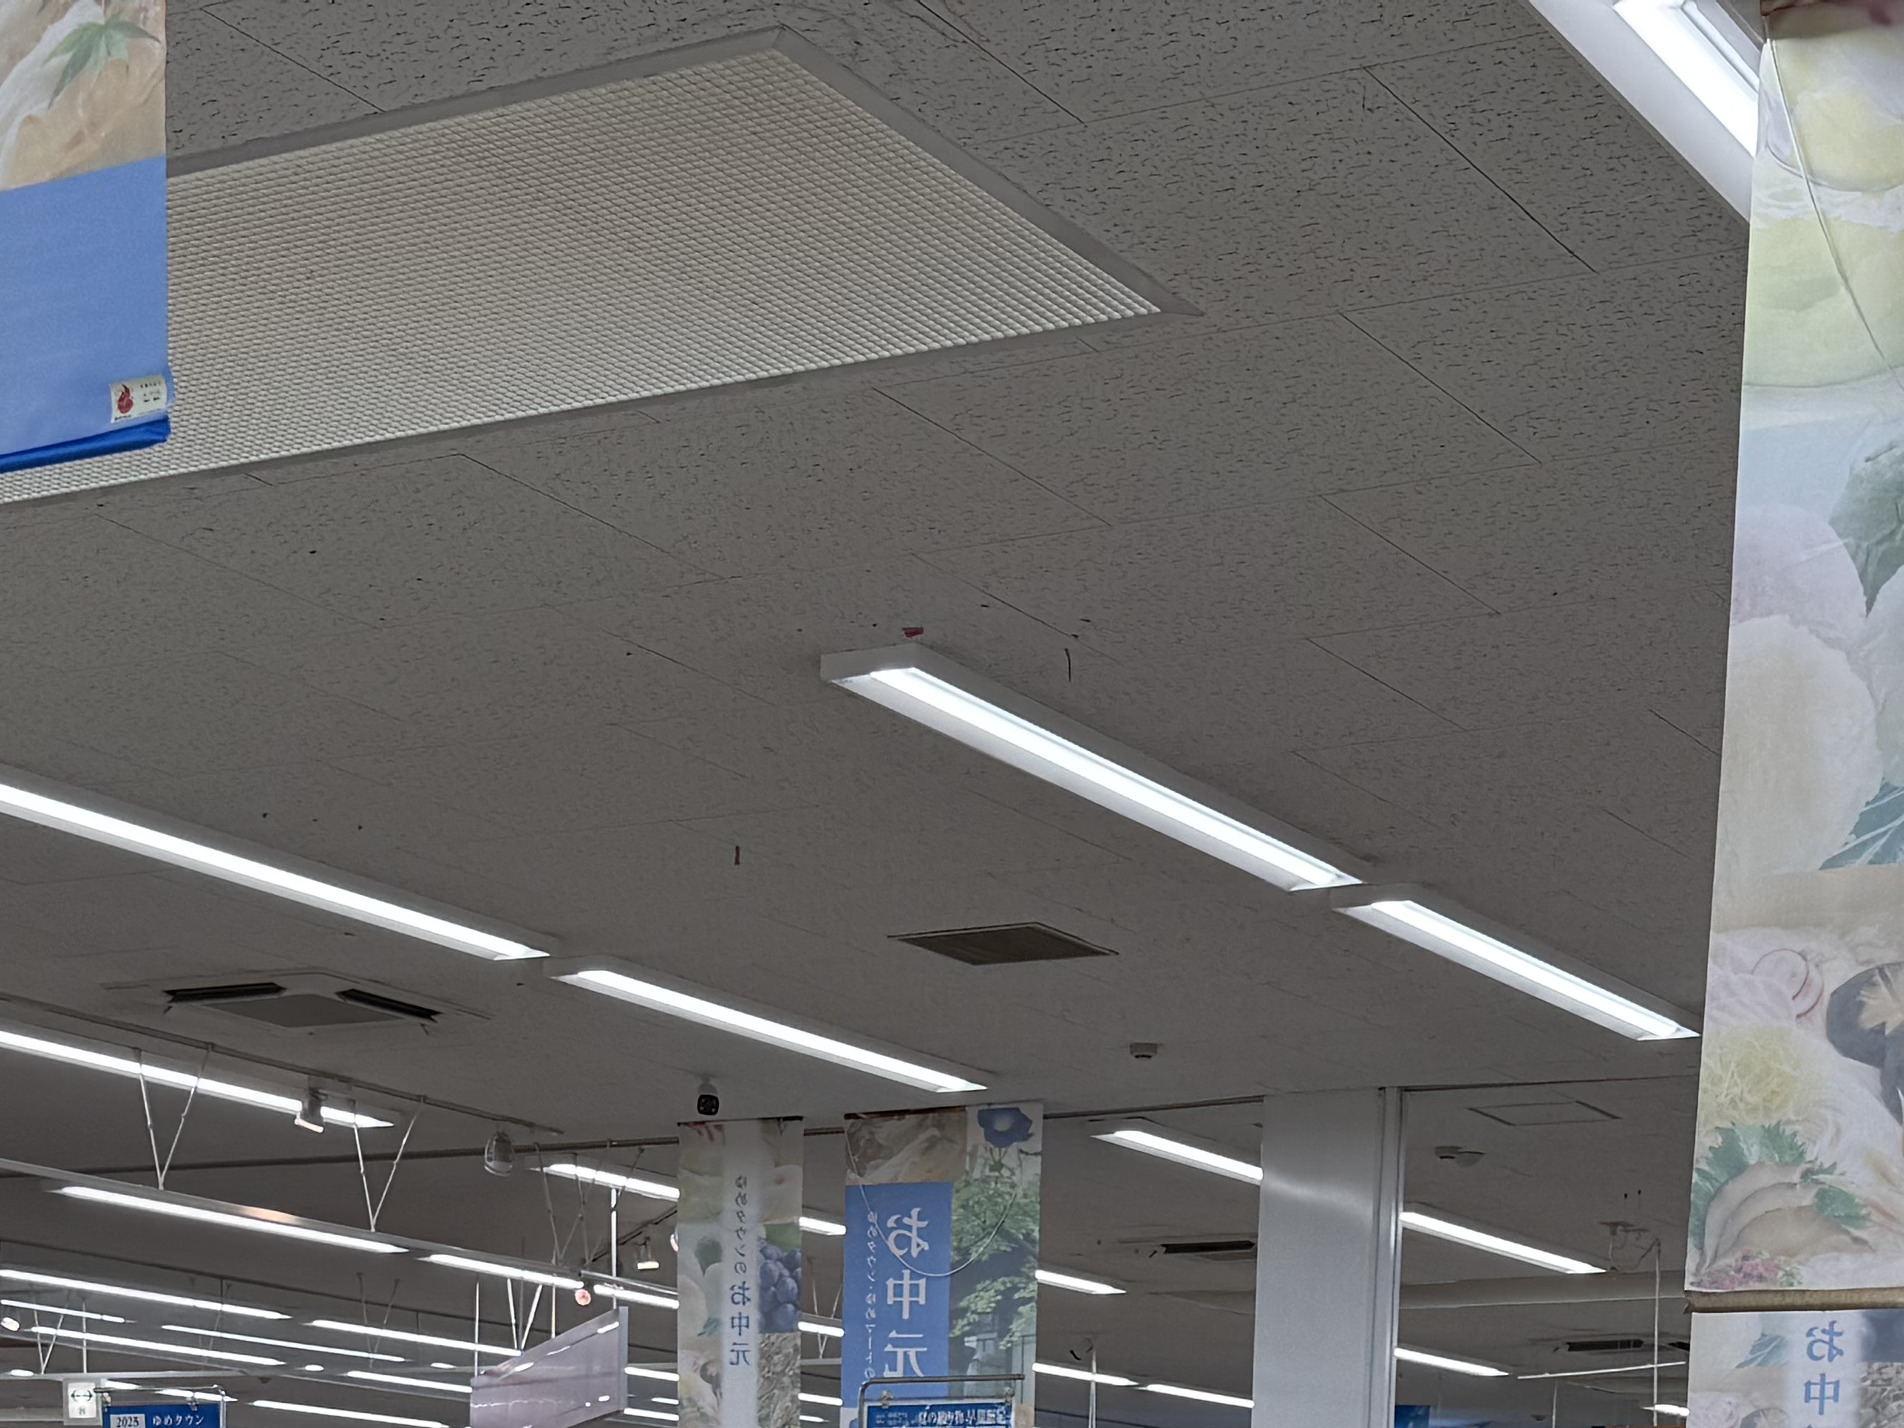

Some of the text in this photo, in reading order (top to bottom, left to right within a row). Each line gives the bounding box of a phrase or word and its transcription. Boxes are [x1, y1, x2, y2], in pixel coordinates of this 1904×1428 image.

[116, 1417, 139, 1428] 2025
[153, 1415, 204, 1427] ゆめタウン
